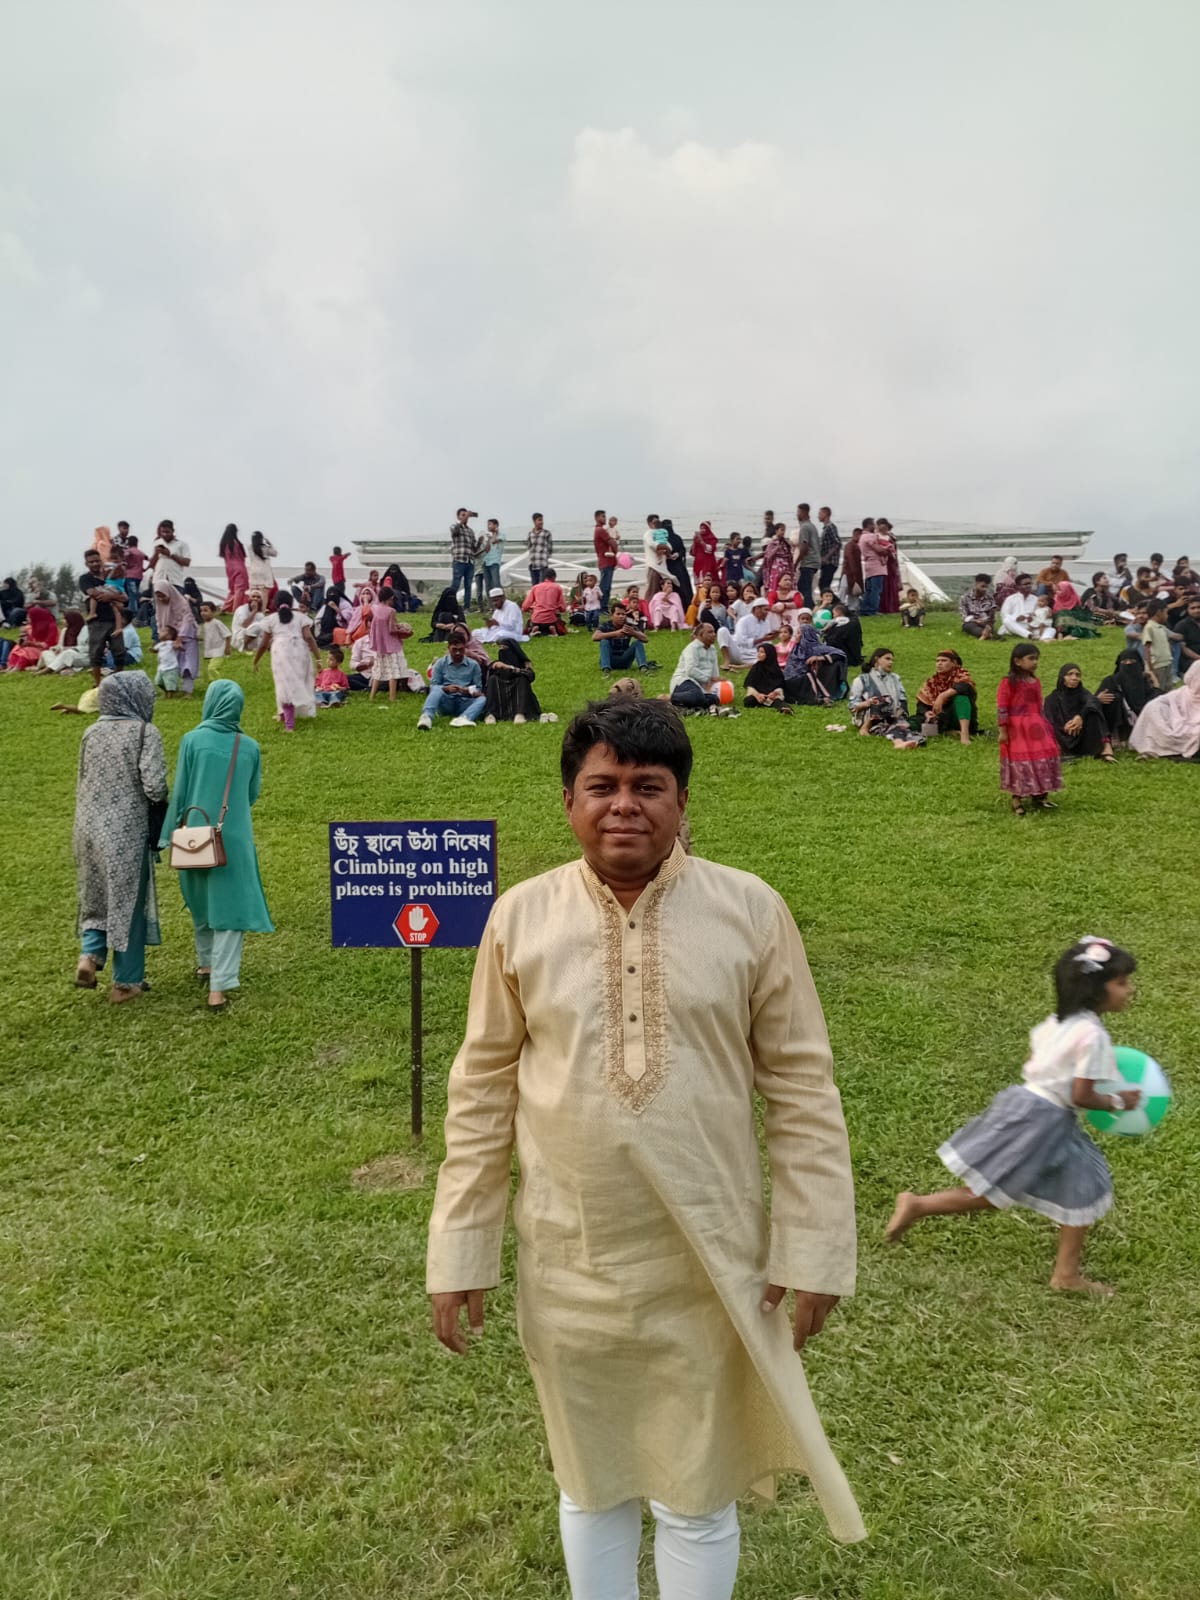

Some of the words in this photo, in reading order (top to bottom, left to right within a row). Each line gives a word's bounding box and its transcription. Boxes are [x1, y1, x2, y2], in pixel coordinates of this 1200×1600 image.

[333, 827, 359, 857] উঁচু
[363, 833, 403, 856] স্থানে
[406, 827, 438, 852] উঠা
[442, 829, 491, 851] নিষেধ
[334, 858, 417, 878] Climbing
[421, 862, 443, 875] on
[449, 858, 488, 878] high
[336, 882, 384, 900] places
[389, 881, 402, 896] is
[408, 881, 493, 899] prohibited
[409, 932, 427, 942] STOP
